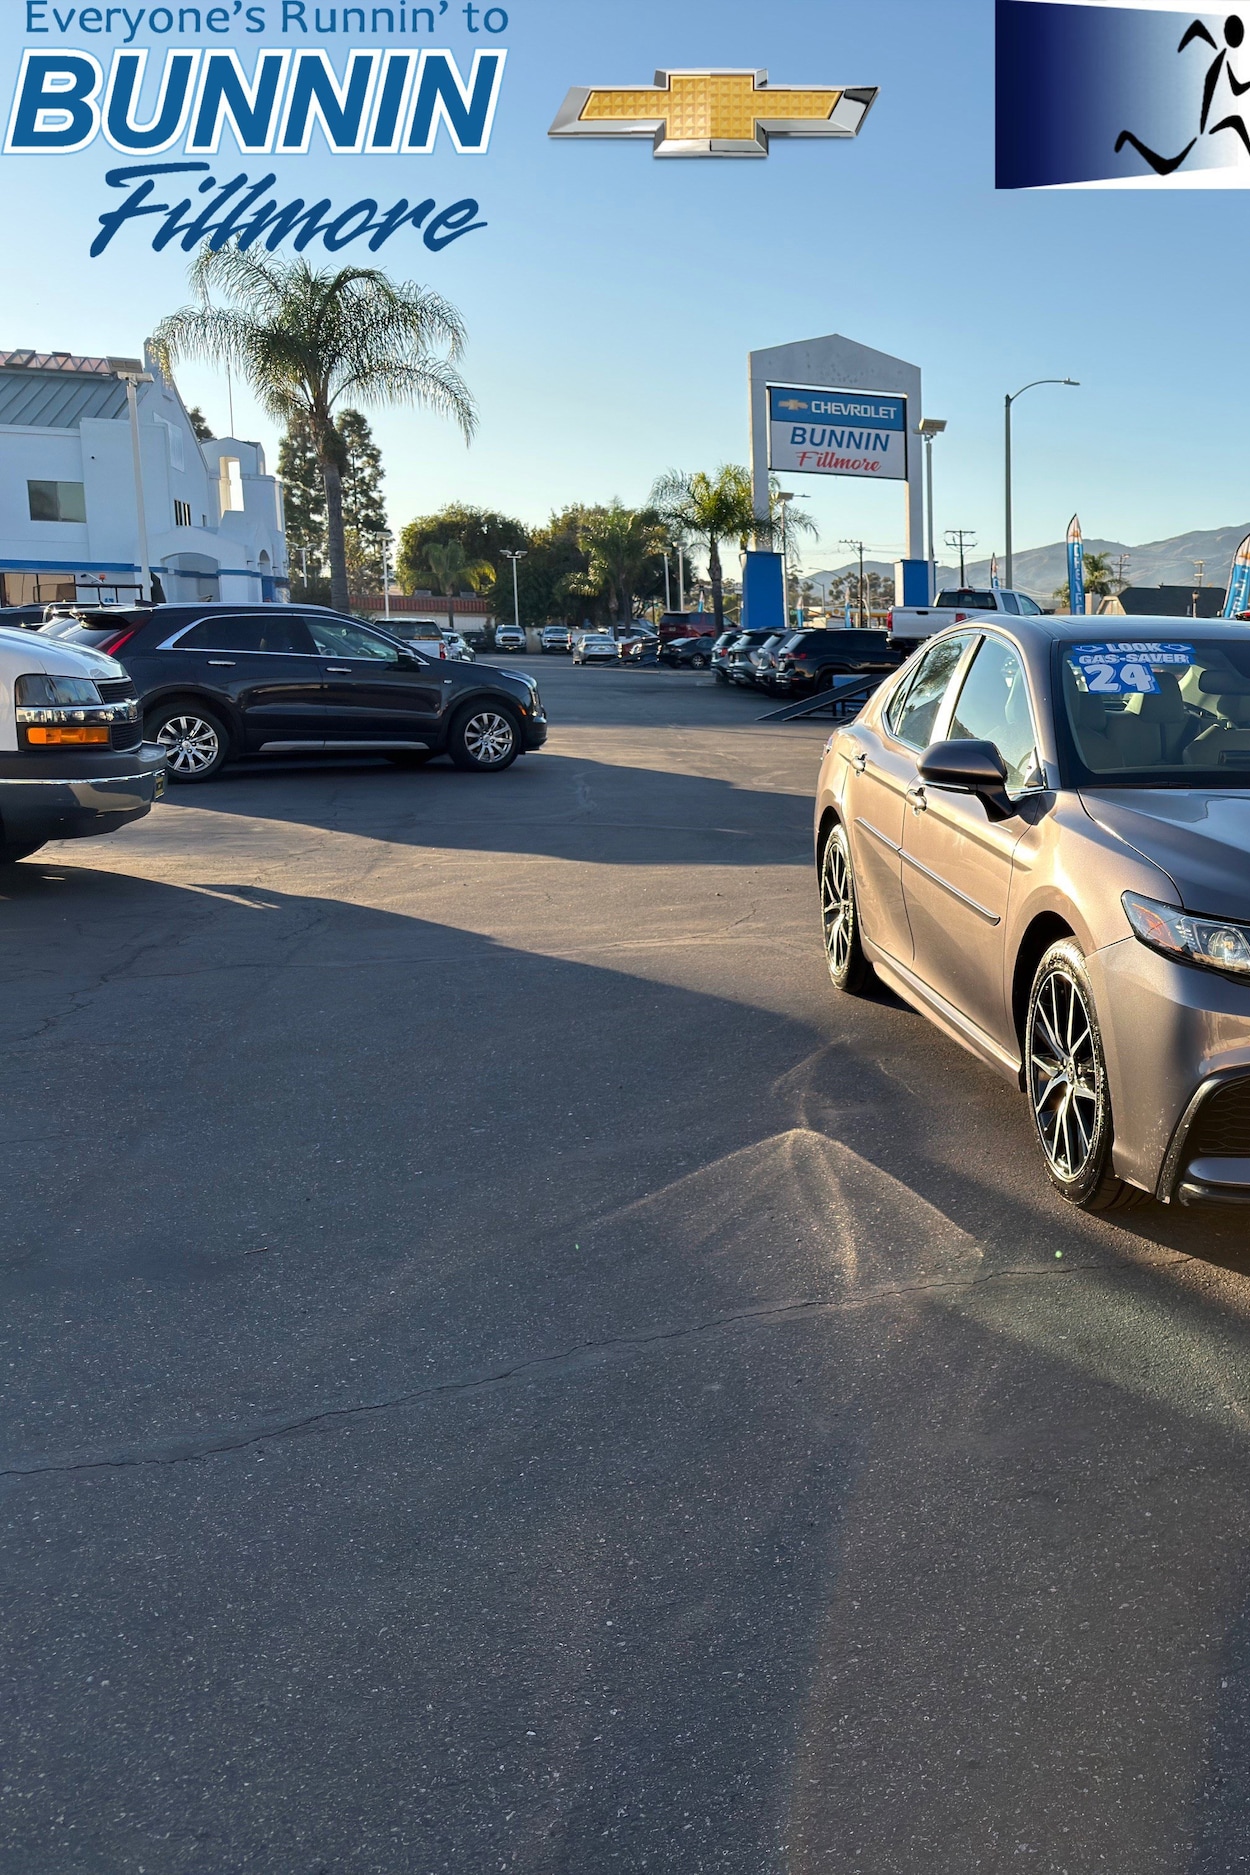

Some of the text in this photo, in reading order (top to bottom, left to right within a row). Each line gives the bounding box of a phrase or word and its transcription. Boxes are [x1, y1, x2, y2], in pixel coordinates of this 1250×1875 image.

[811, 400, 897, 419] CHEVROLET
[790, 426, 890, 452] BUNNIN
[794, 450, 882, 472] Fillmore
[1106, 643, 1165, 653] LOOK
[1084, 664, 1156, 692] 24
